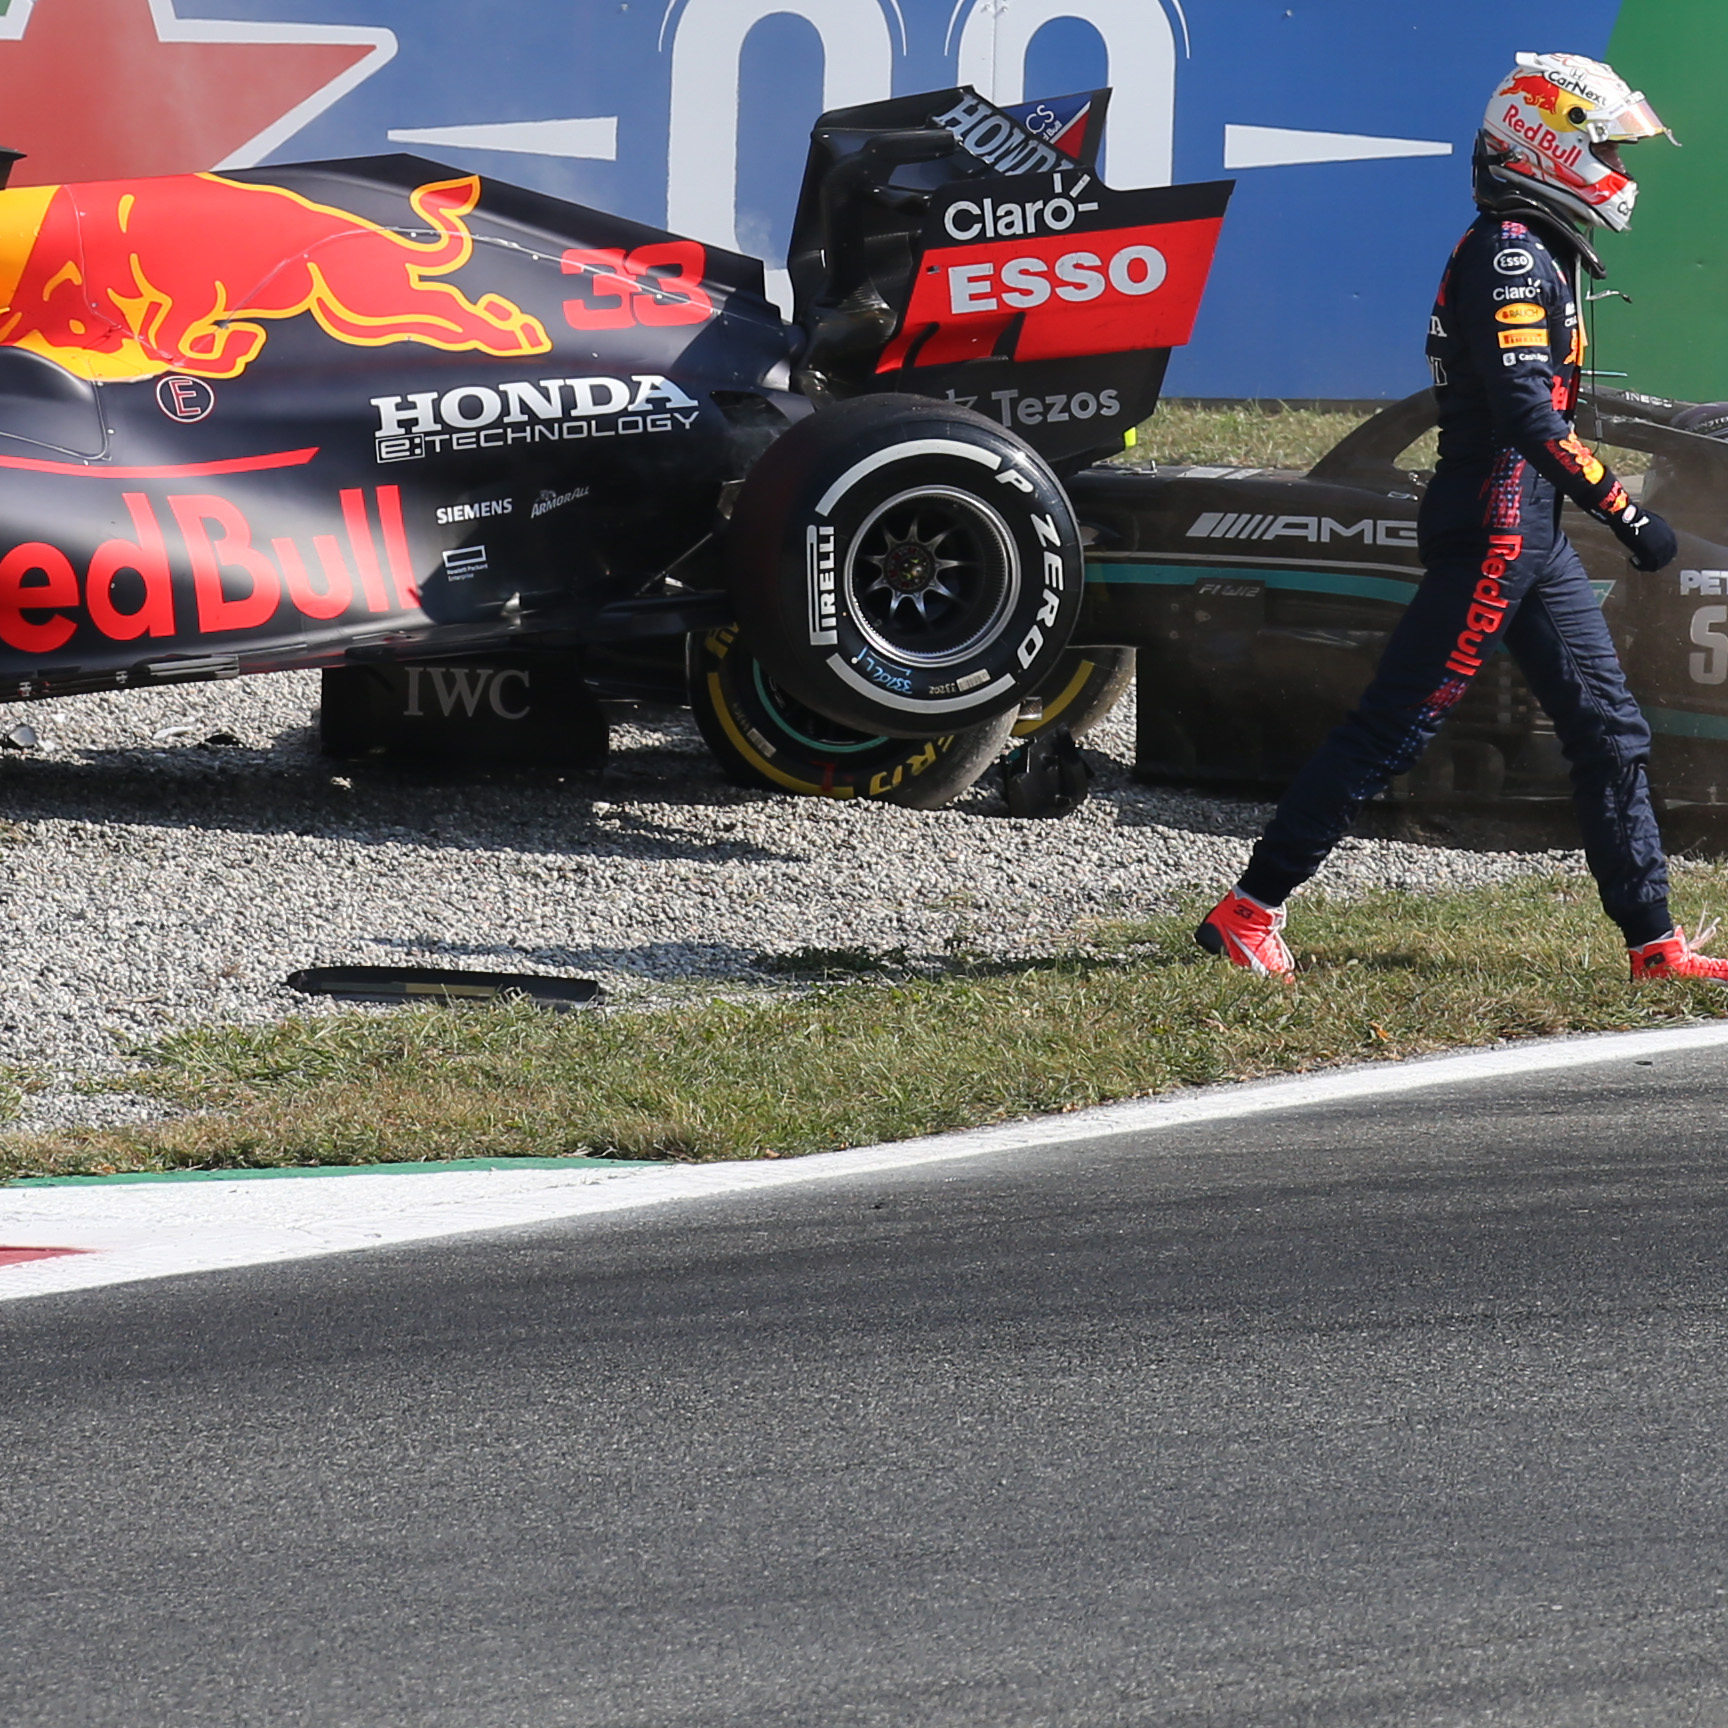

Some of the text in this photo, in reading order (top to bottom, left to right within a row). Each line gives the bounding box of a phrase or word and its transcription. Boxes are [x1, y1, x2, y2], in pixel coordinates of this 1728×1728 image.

[944, 194, 1076, 241] Claro
[561, 240, 712, 332] 33
[947, 245, 1168, 314] ESSO
[370, 374, 700, 438] HONDA
[991, 387, 1121, 428] Tezos
[436, 497, 514, 525] SIEMENS
[1262, 515, 1419, 548] AMG
[805, 524, 838, 646] PIRELLI
[994, 468, 1065, 670] P ZERO
[403, 666, 531, 721] IWC
